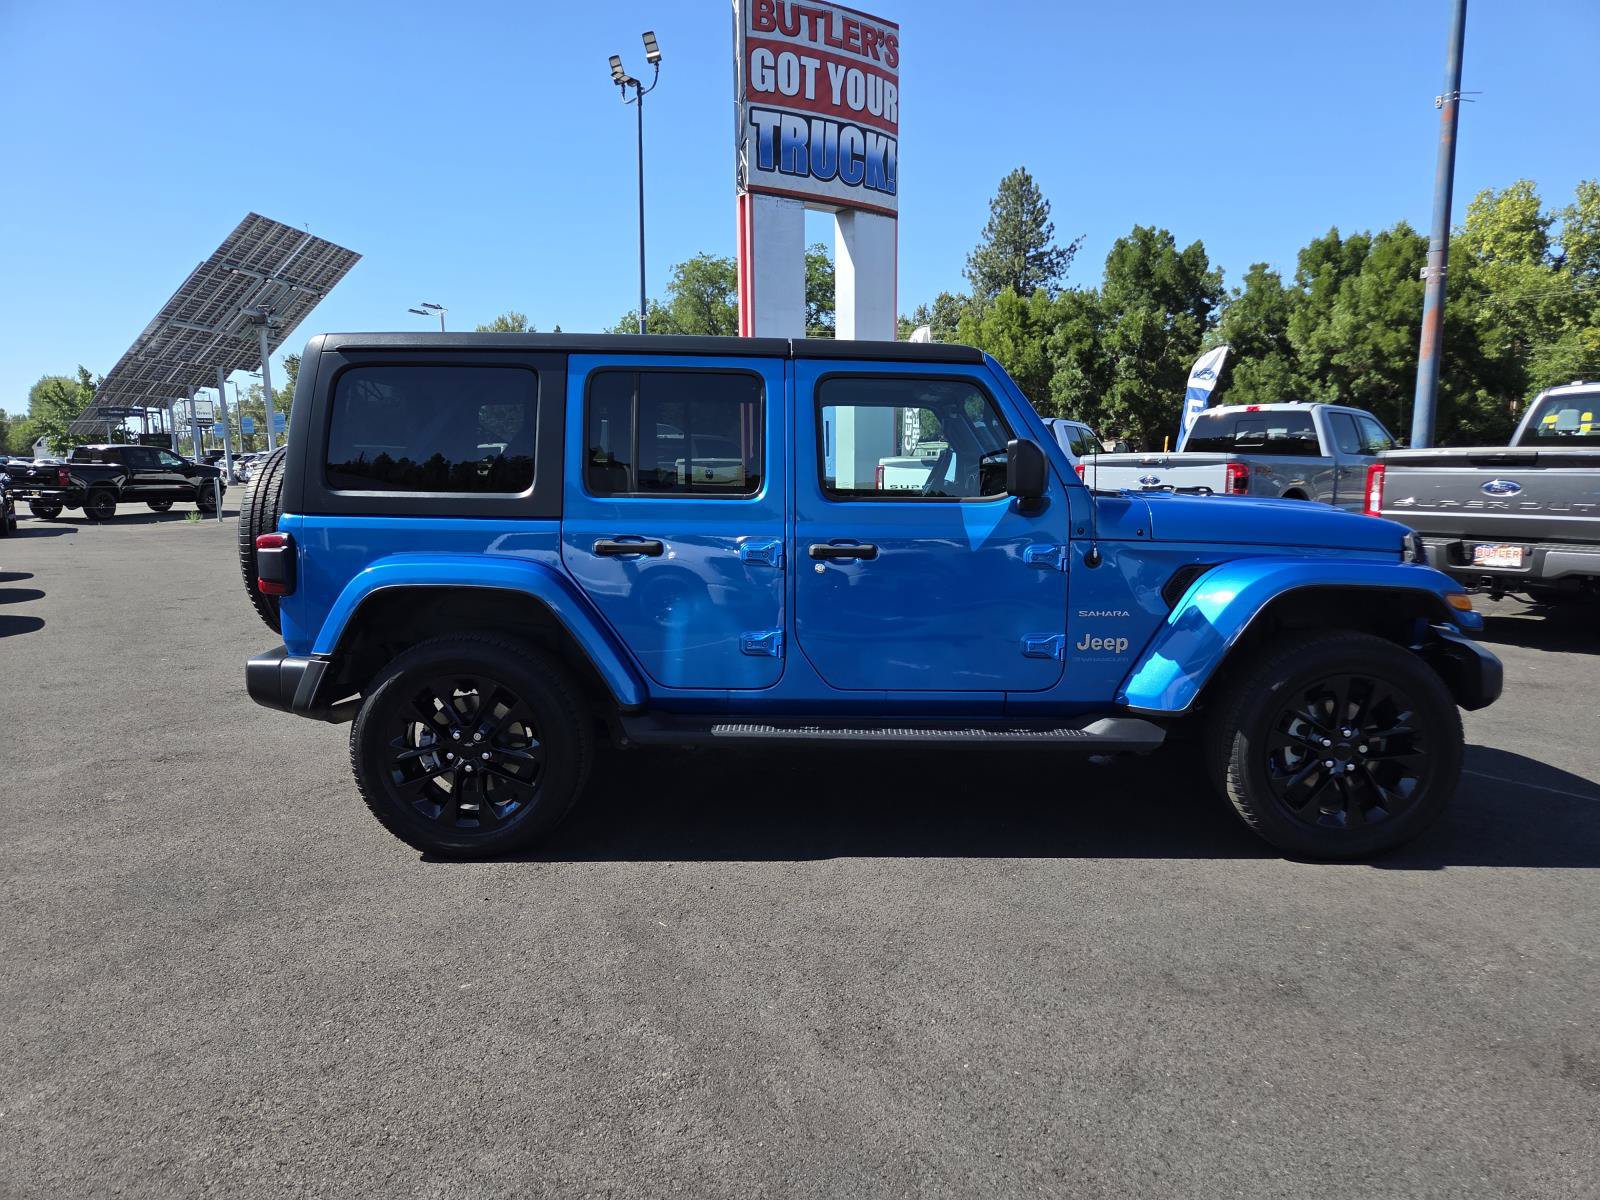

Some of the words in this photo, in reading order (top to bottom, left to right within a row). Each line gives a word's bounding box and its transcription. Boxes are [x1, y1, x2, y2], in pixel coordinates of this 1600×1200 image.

[752, 0, 899, 69] BUTLER'S
[751, 47, 821, 101] GOT
[826, 60, 898, 125] YOUR
[750, 107, 897, 195] TRUCK!
[1519, 501, 1599, 512] DUT
[1475, 547, 1521, 559] BUTLER
[1076, 633, 1129, 654] Jeep
